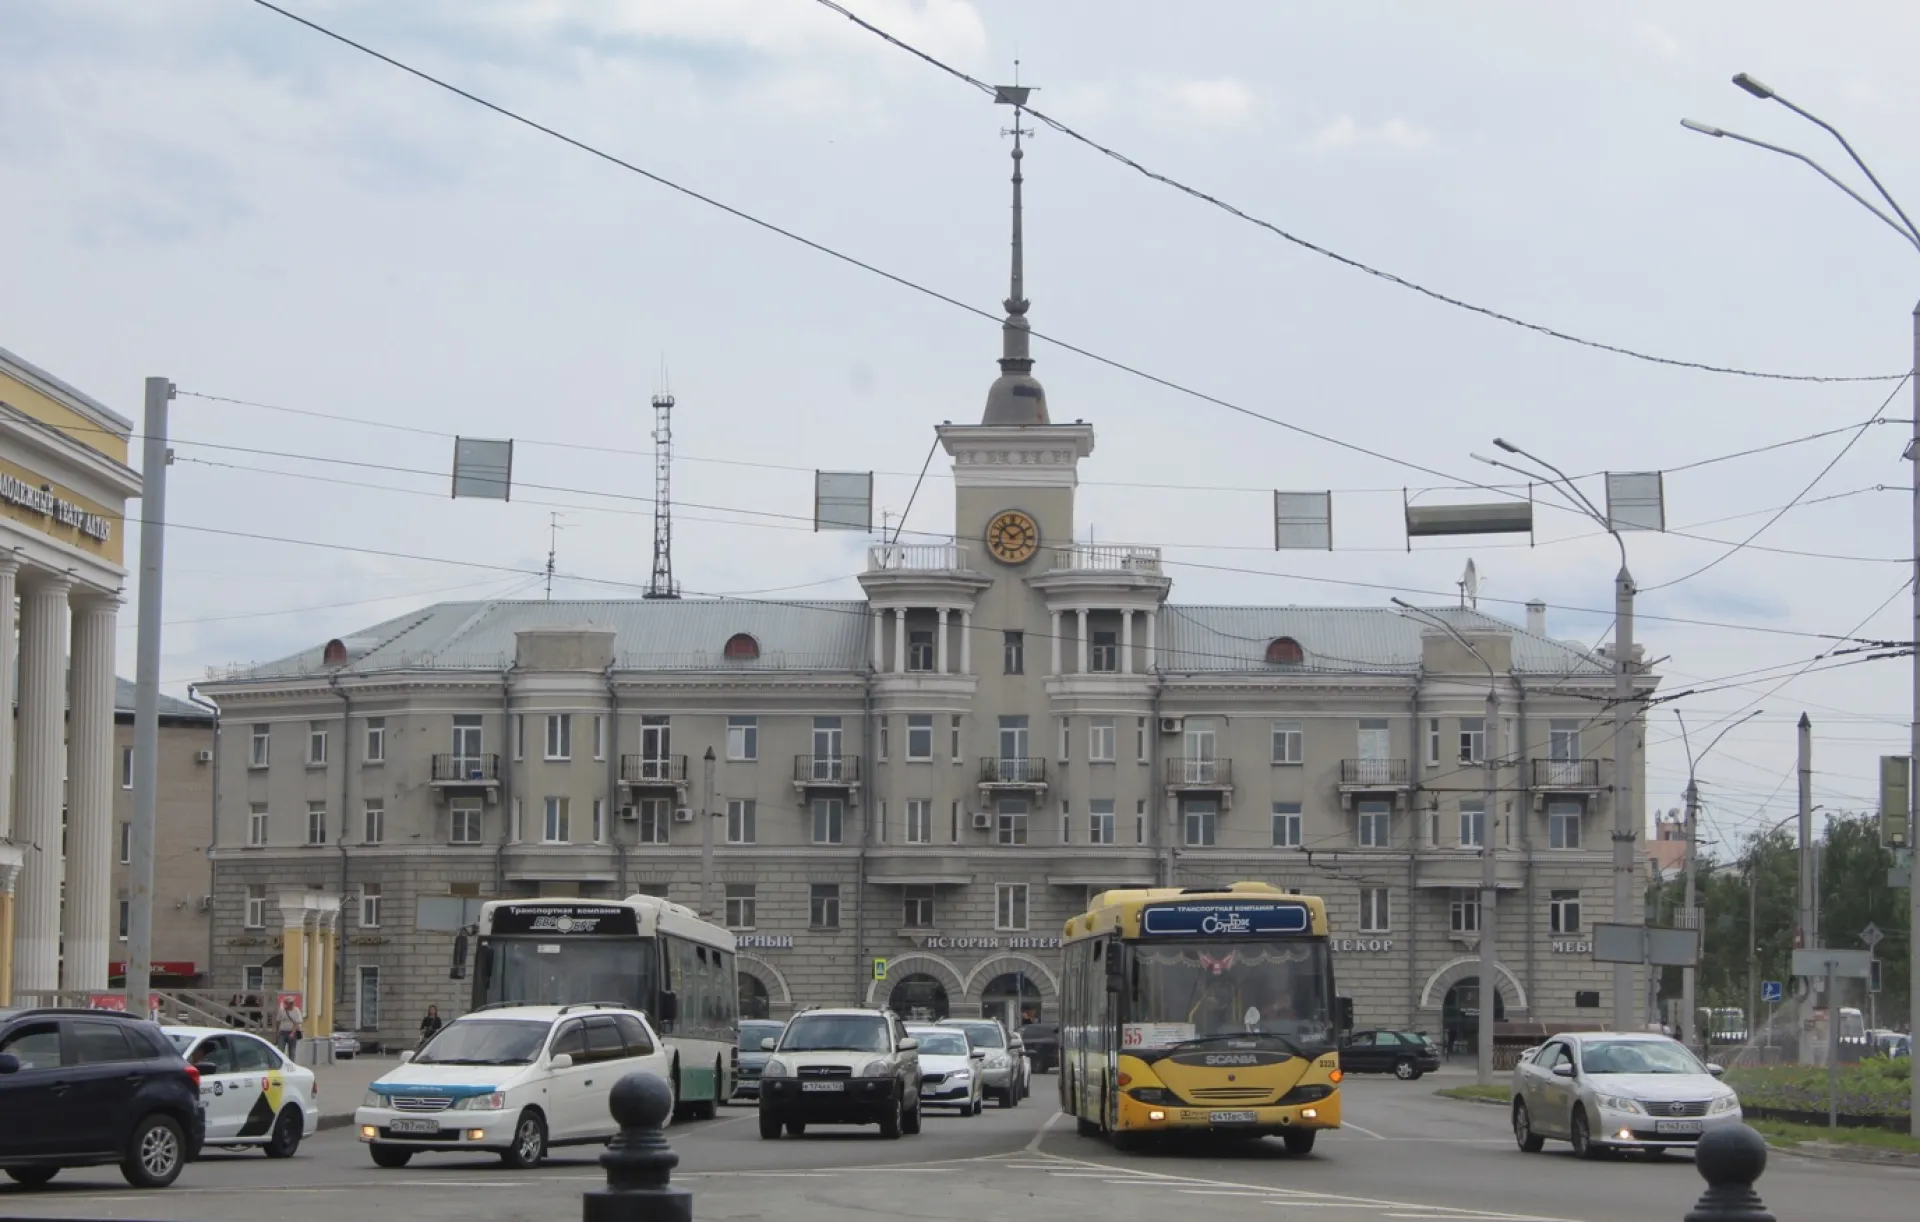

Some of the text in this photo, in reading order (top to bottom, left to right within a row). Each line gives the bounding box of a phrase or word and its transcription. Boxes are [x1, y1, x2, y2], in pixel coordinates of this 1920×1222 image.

[58, 499, 83, 529] ТЕАТР
[86, 514, 111, 541] АЛТАЯ
[509, 906, 621, 915] Транспортная компания
[1178, 904, 1275, 913] ТРАНСПОРТНАЯ КОМПАНИЯ
[927, 937, 999, 949] ИСТОРИЯ
[1123, 1027, 1143, 1045] 55
[1205, 1054, 1258, 1065] SCANIA
